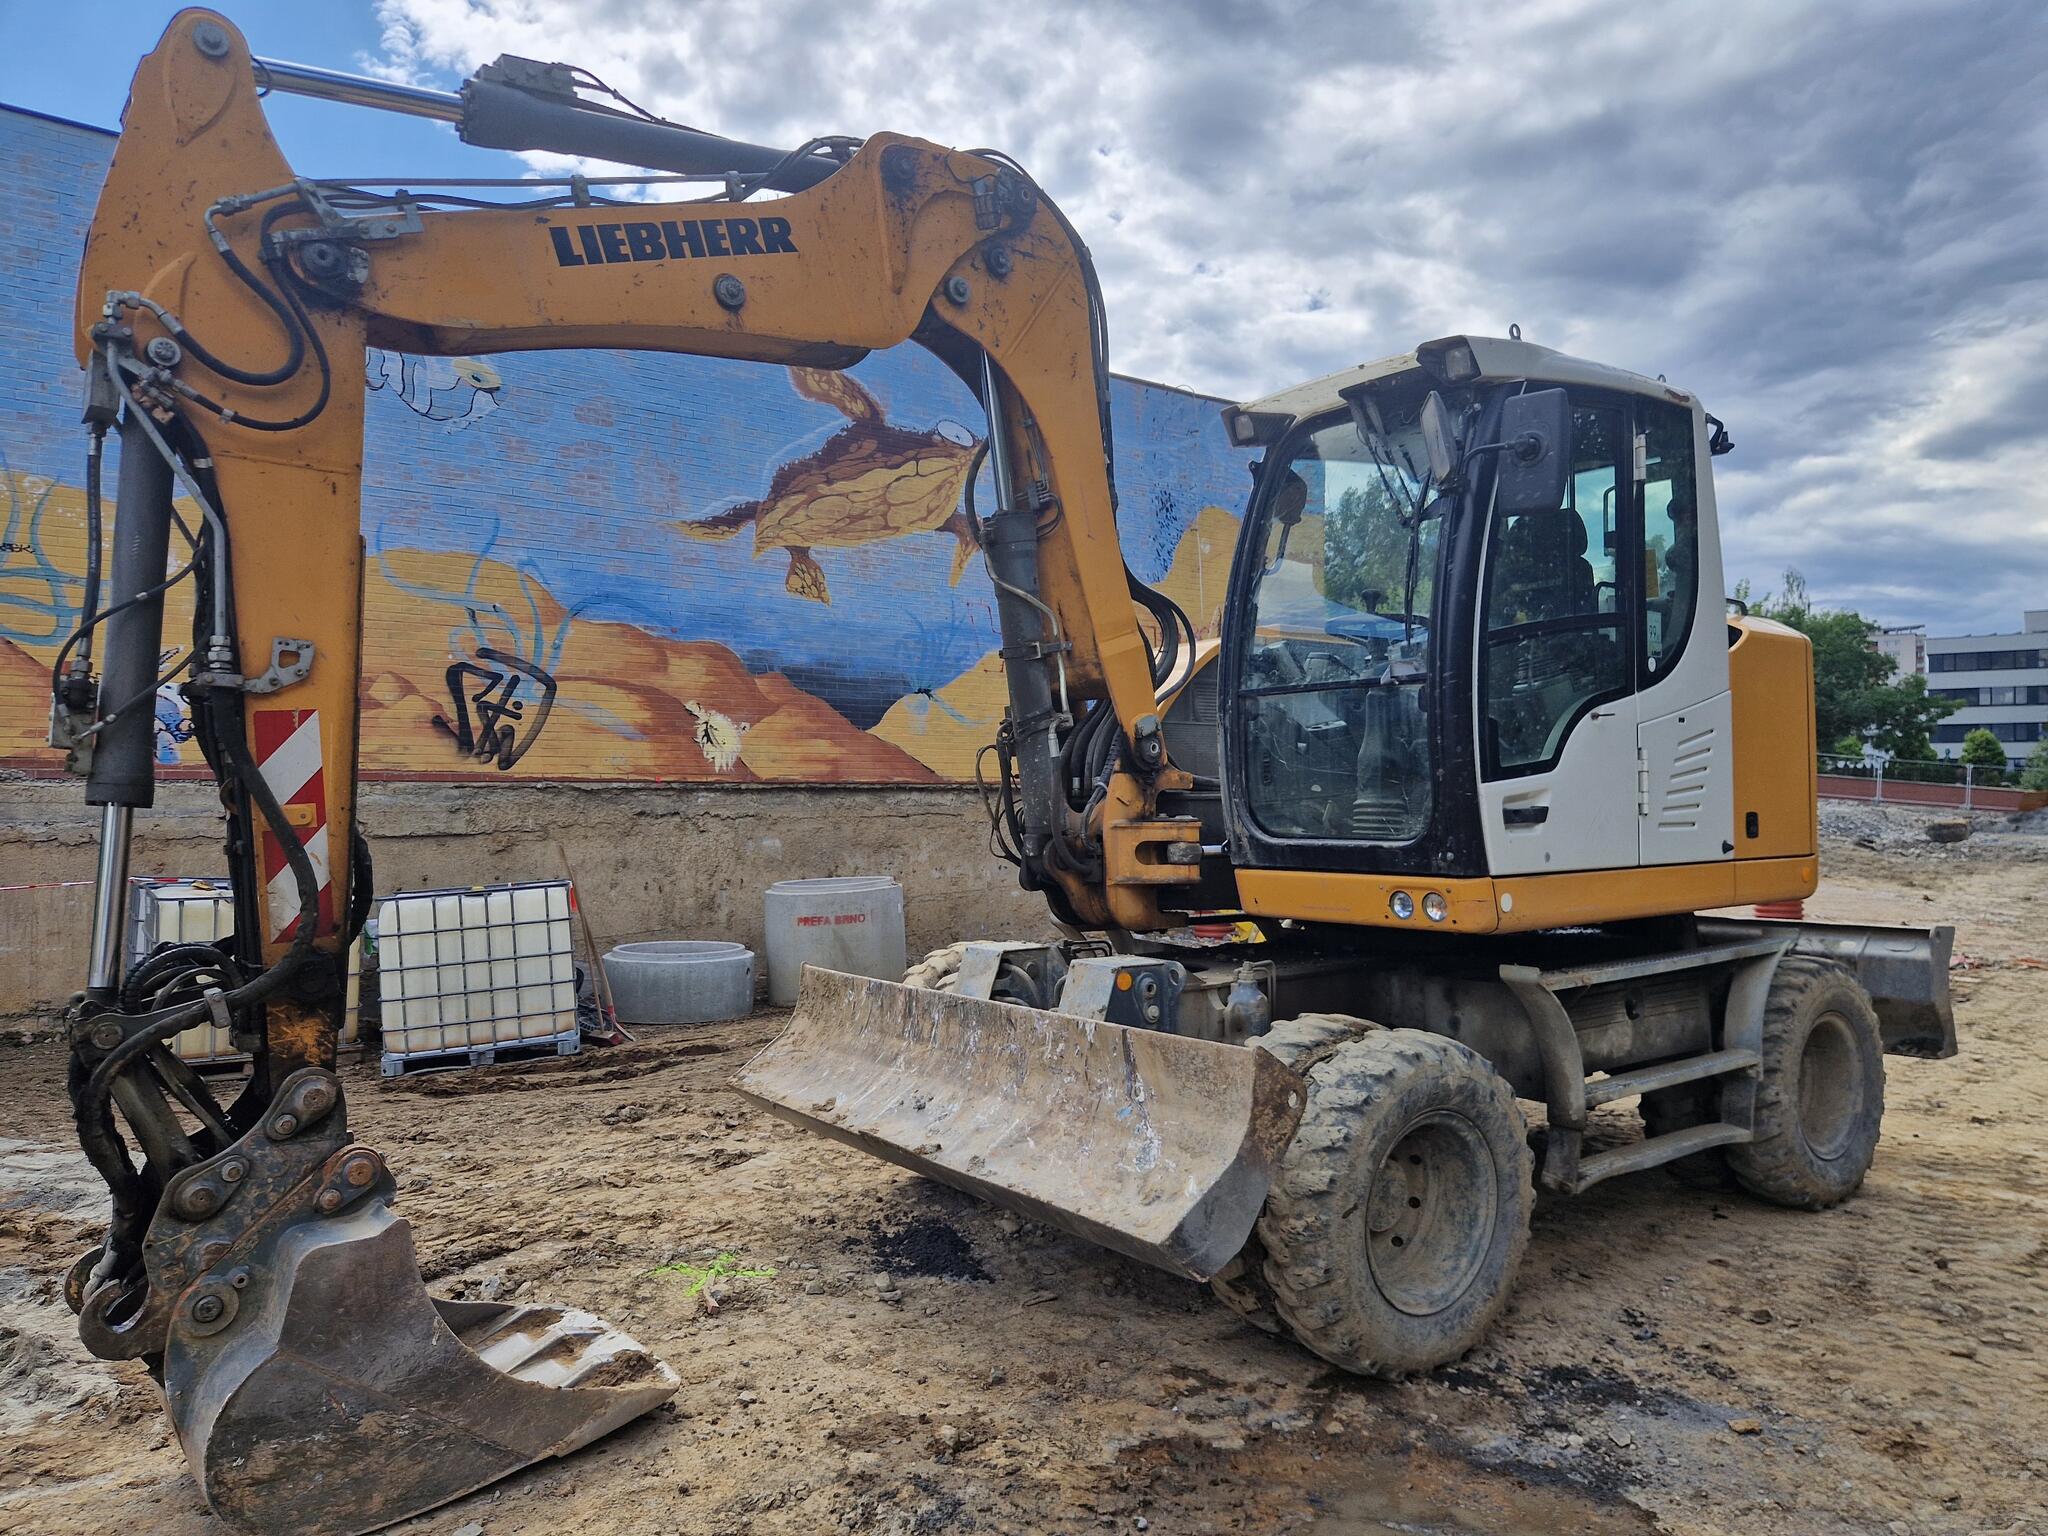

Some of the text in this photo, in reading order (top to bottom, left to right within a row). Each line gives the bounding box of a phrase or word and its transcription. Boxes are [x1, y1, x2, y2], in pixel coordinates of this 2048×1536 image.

[549, 216, 800, 267] LIEBHERR
[797, 913, 866, 927] PREFA BRNO
